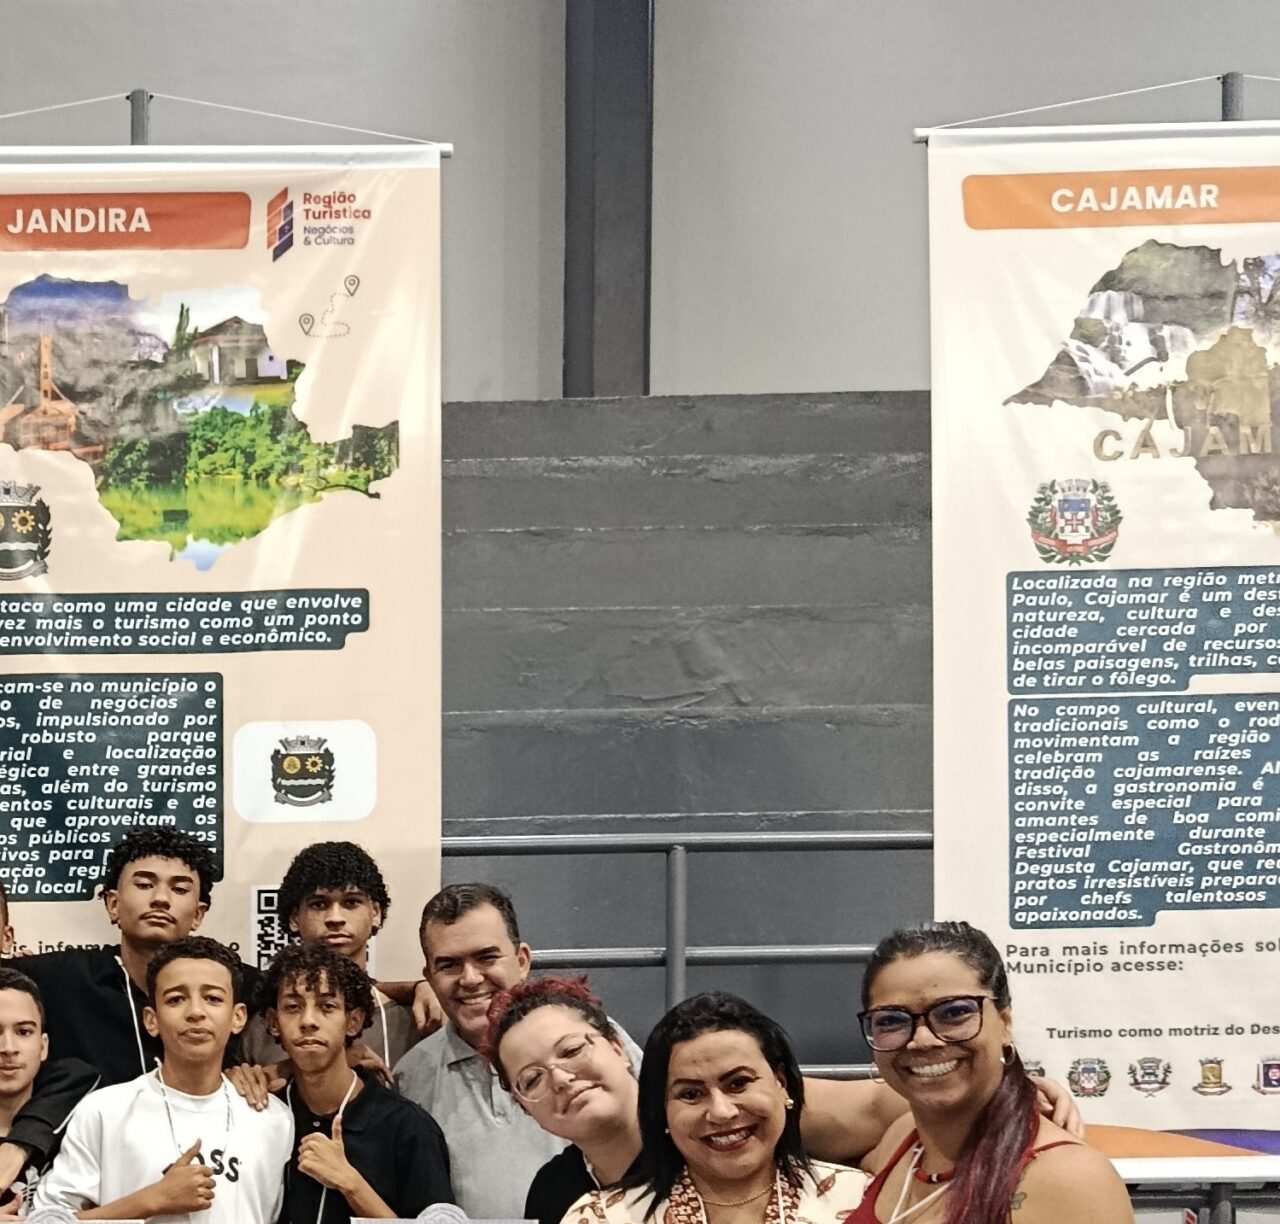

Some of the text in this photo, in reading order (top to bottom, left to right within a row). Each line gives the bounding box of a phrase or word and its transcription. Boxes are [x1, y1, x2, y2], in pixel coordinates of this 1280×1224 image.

[302, 191, 357, 208] Região
[1050, 183, 1220, 213] CAJAMAR
[6, 206, 152, 237] JANDIRA
[303, 206, 372, 220] Turística
[303, 224, 354, 237] Negócios
[303, 236, 355, 246] & Cultura
[1011, 570, 1228, 592] Localizada na região
[51, 600, 107, 613] como
[113, 599, 158, 612] uma
[165, 595, 233, 612] cidade
[240, 597, 279, 613] que
[285, 593, 363, 610] envolve
[1012, 586, 1233, 609] Paulo, Cajamar é um
[35, 613, 83, 630] mais
[92, 618, 105, 630] o
[114, 612, 190, 630] turismo
[199, 615, 254, 629] como
[263, 613, 295, 627] um
[303, 611, 363, 628] ponto
[1011, 604, 1232, 626] natureza, cultura e
[137, 630, 197, 646] social
[201, 634, 214, 646] e
[219, 627, 332, 645] econômico.
[1012, 620, 1268, 639] cidade cercada por
[1012, 637, 1188, 659] incomparável de
[1012, 651, 1258, 674] belas paisagens, trilhas,
[69, 680, 95, 693] no
[100, 676, 198, 698] município
[204, 679, 217, 692] o
[1012, 668, 1176, 688] de tirar o fôlego.
[38, 694, 63, 709] de
[90, 693, 179, 715] negócios
[204, 697, 217, 709] e
[1013, 698, 1279, 721] No campo cultural, even
[36, 710, 170, 732] impulsionado
[183, 714, 218, 729] por
[21, 728, 98, 744] robusto
[146, 730, 217, 748] parque
[1014, 761, 1243, 784] tradição cajamarense.
[1014, 824, 1266, 847] especialmente durante
[35, 880, 87, 895] local.
[1014, 905, 1143, 924] apaixonados.
[1006, 938, 1244, 958] Para mais informações
[1006, 958, 1184, 978] Município acesse:
[1045, 1022, 1245, 1039] Turismo como motriz do
